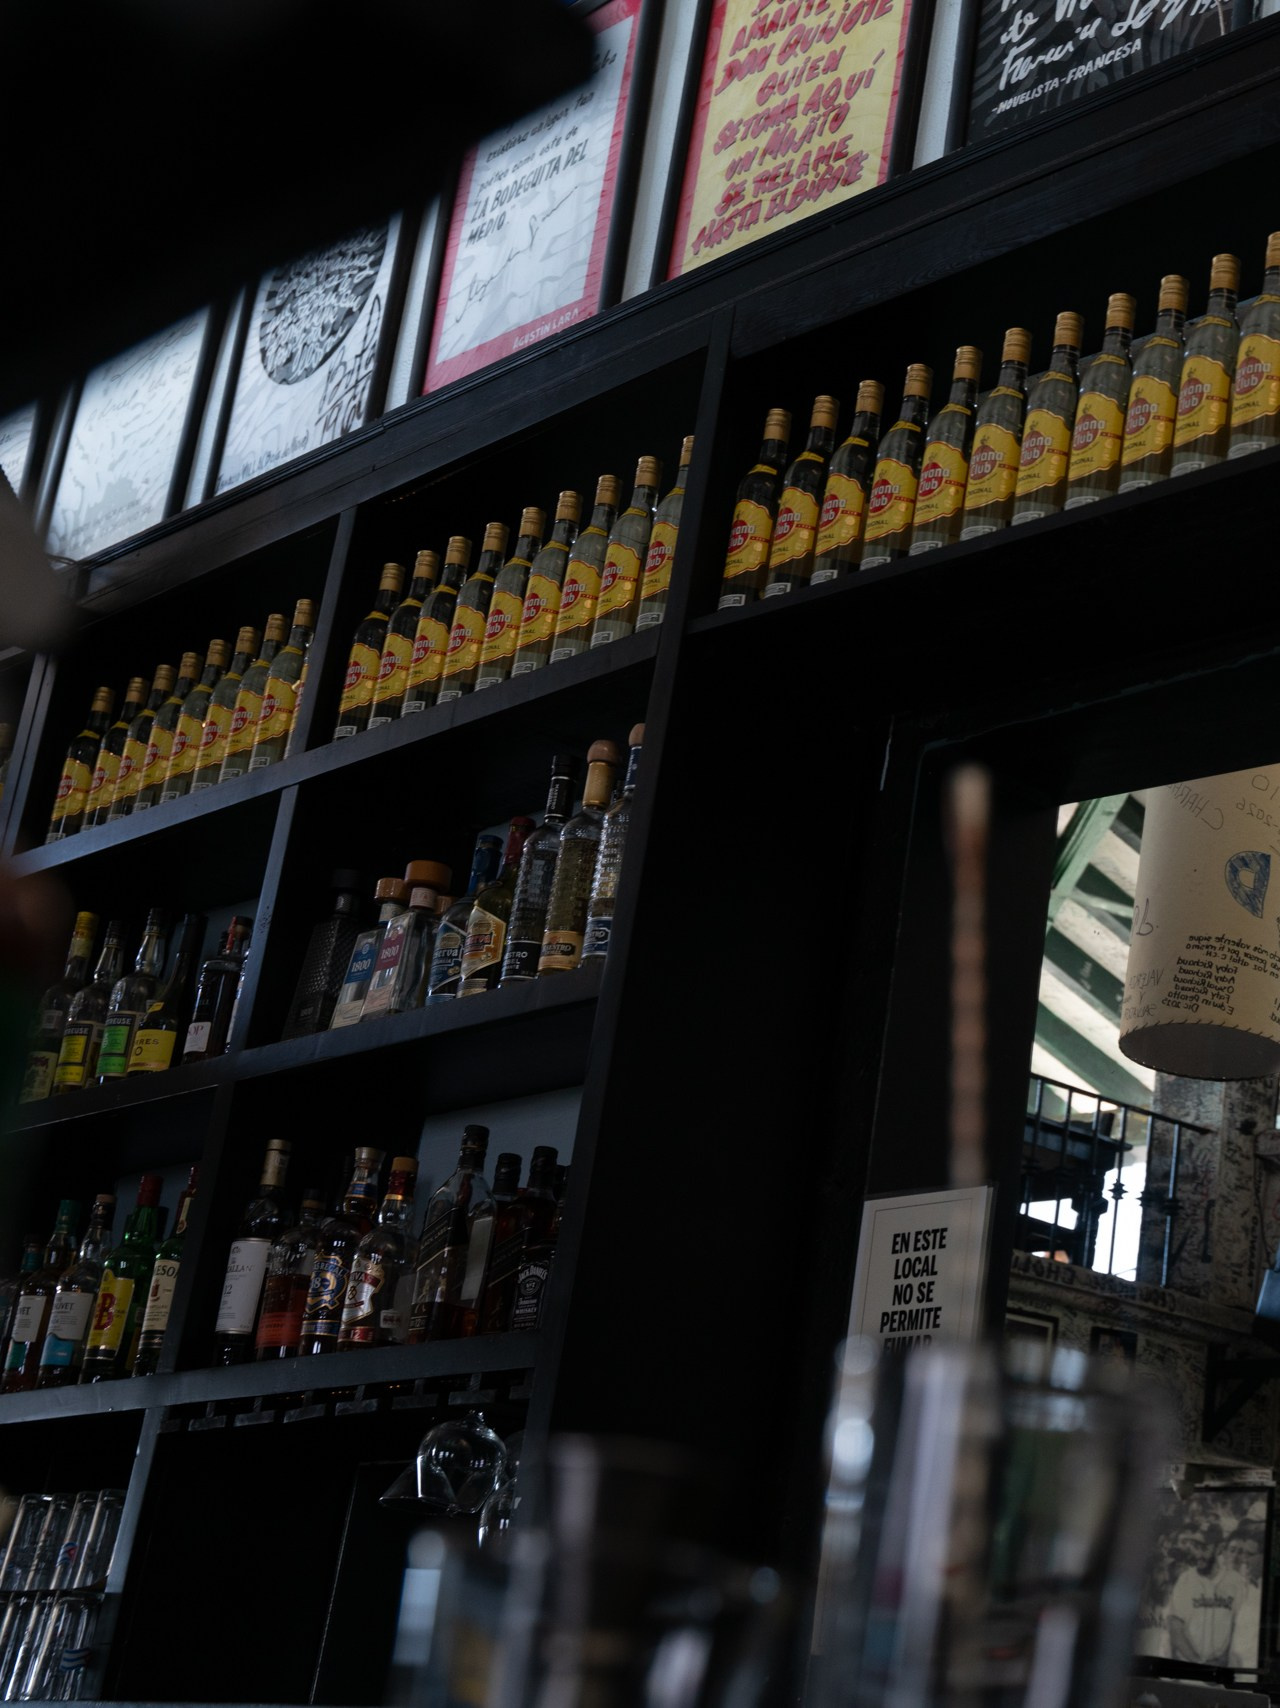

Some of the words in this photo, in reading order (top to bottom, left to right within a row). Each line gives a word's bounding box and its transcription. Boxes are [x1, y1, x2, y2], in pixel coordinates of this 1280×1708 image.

[490, 155, 563, 213] BODEGUITA
[562, 138, 589, 171] DEL
[752, 134, 854, 198] RELAME
[891, 1231, 911, 1255] EN
[912, 1227, 948, 1252] ESTE
[893, 1255, 938, 1280] LOCAL
[891, 1283, 913, 1306] NO
[916, 1281, 935, 1304] SE
[879, 1306, 942, 1333] PERMITE
